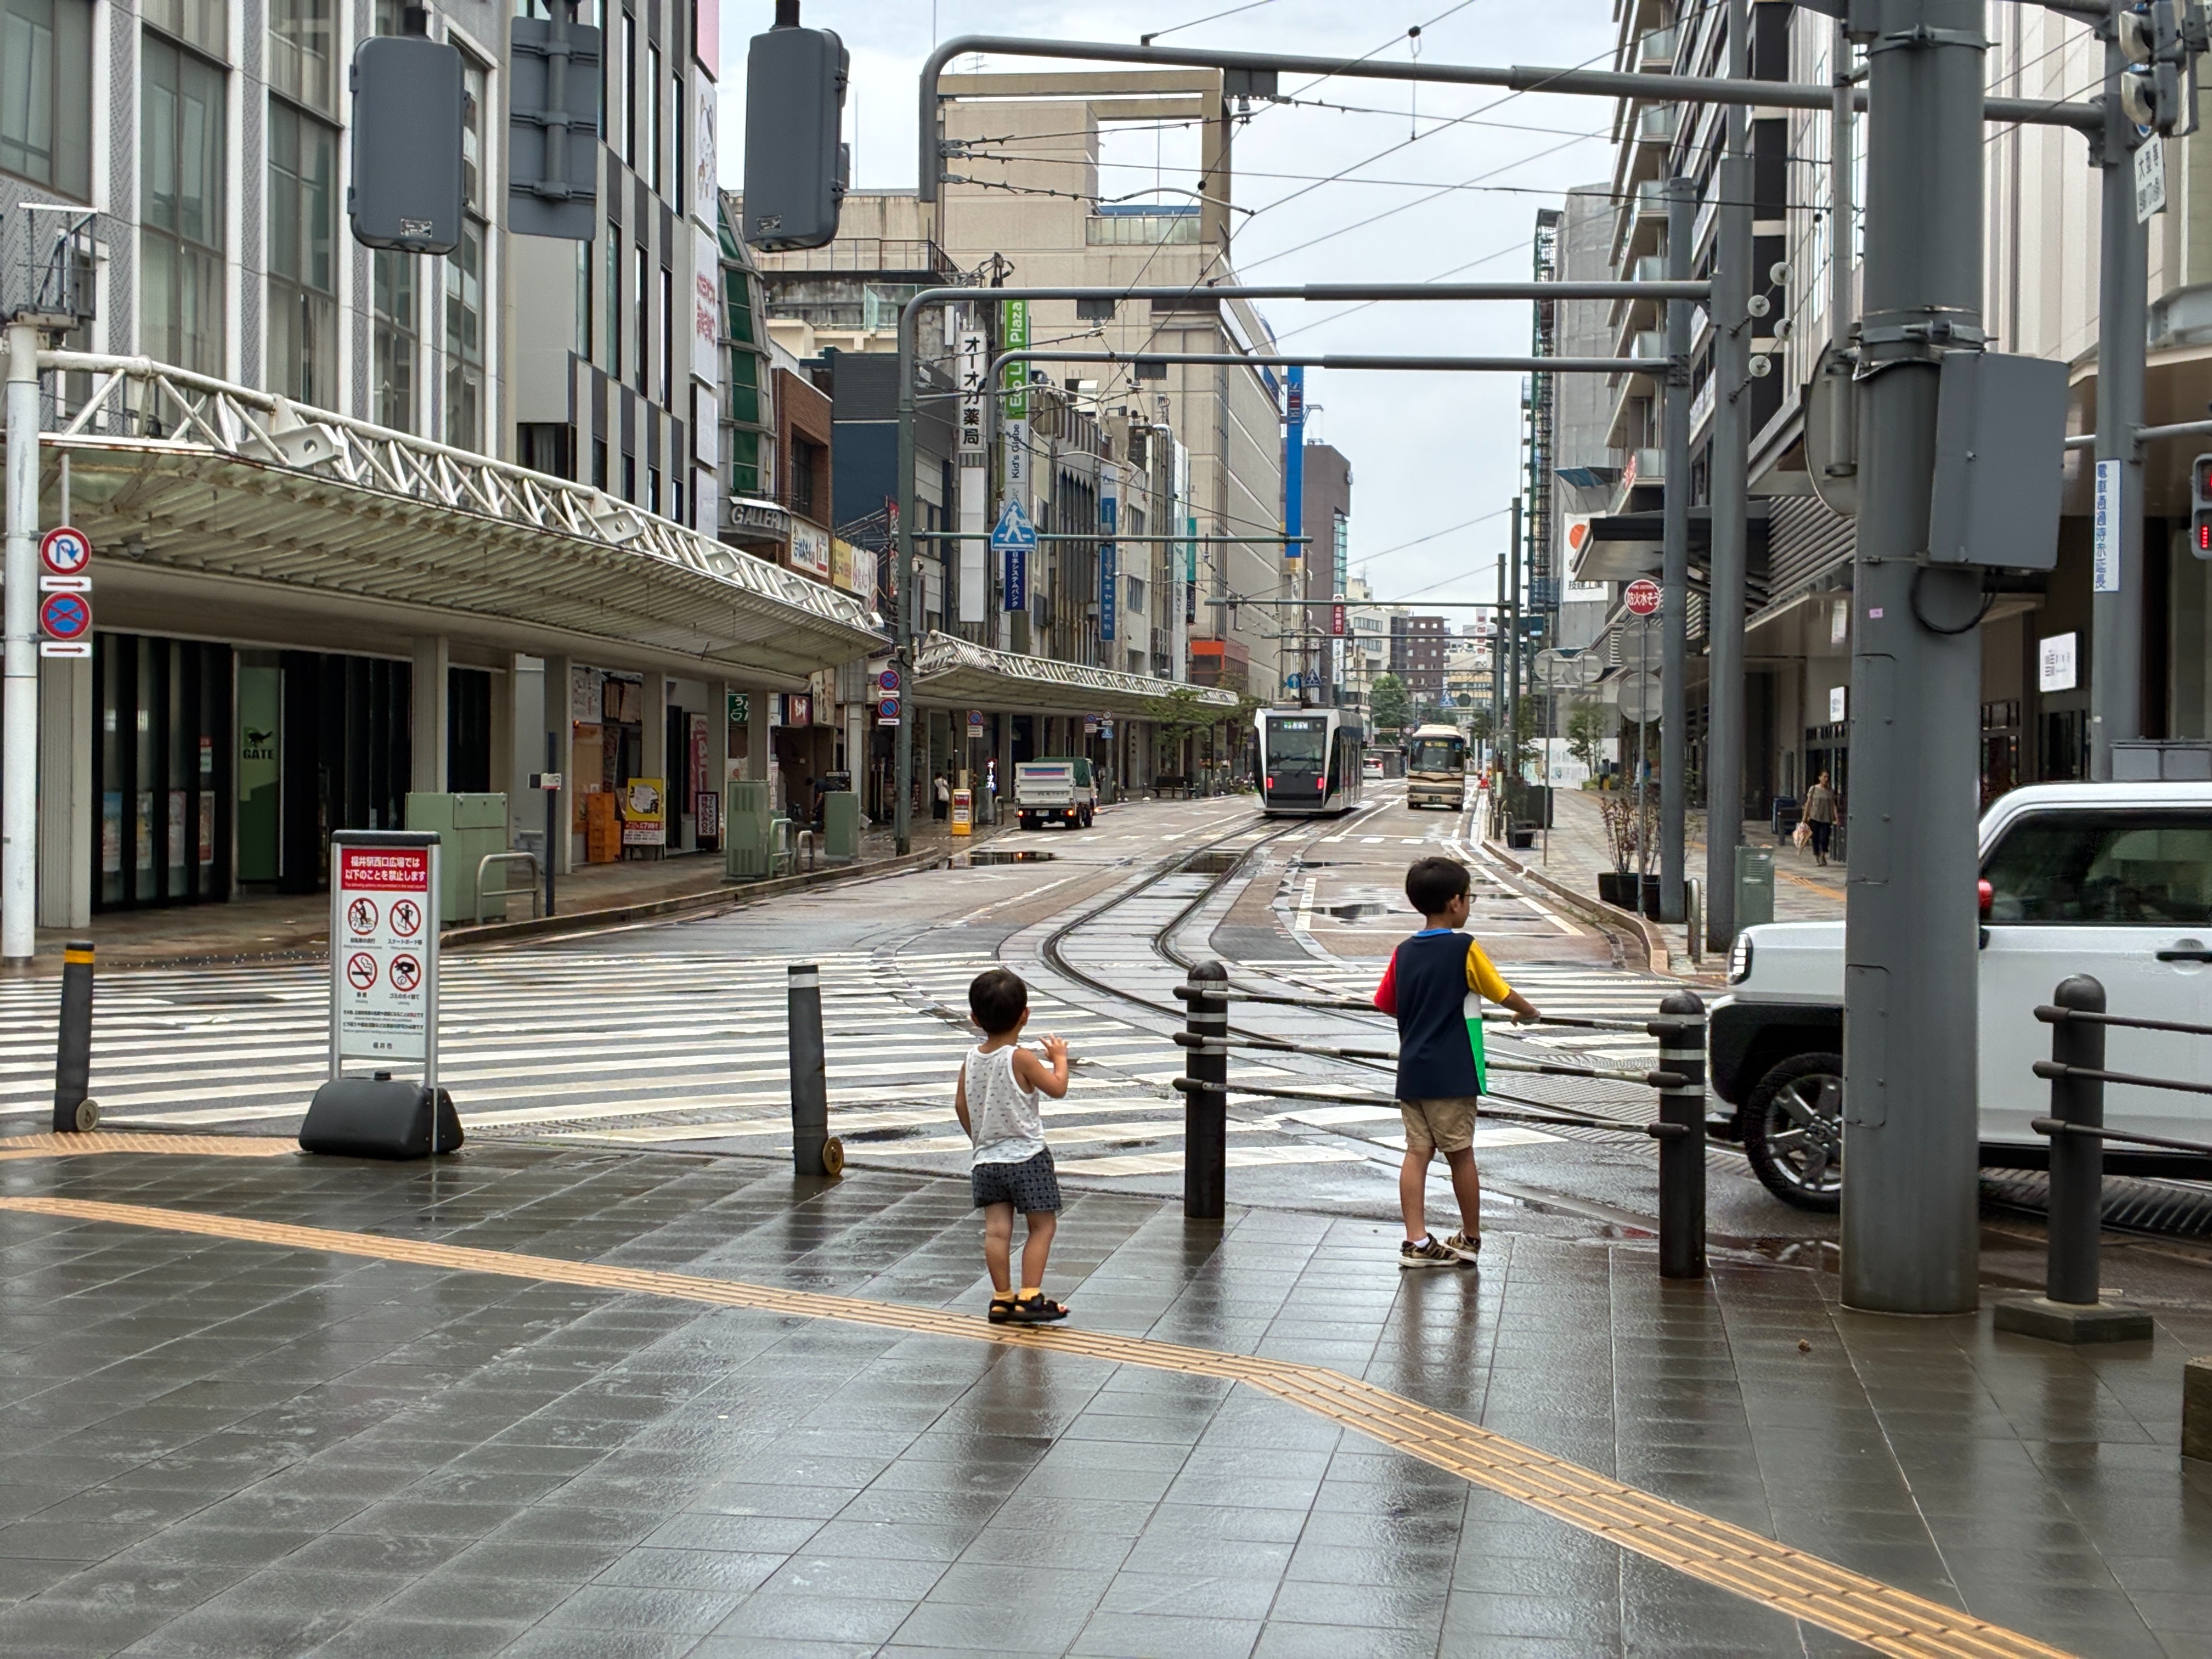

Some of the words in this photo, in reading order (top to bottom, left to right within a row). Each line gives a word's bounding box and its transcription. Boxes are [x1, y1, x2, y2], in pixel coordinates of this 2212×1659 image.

[1010, 302, 1022, 342] Plaza
[963, 336, 980, 445] オーオカ薬局
[1627, 591, 1659, 607] 防火水そう
[243, 748, 274, 760] GATE
[351, 856, 420, 868] 福井駅西口広場では
[345, 869, 426, 882] 以下のことを禁止します
